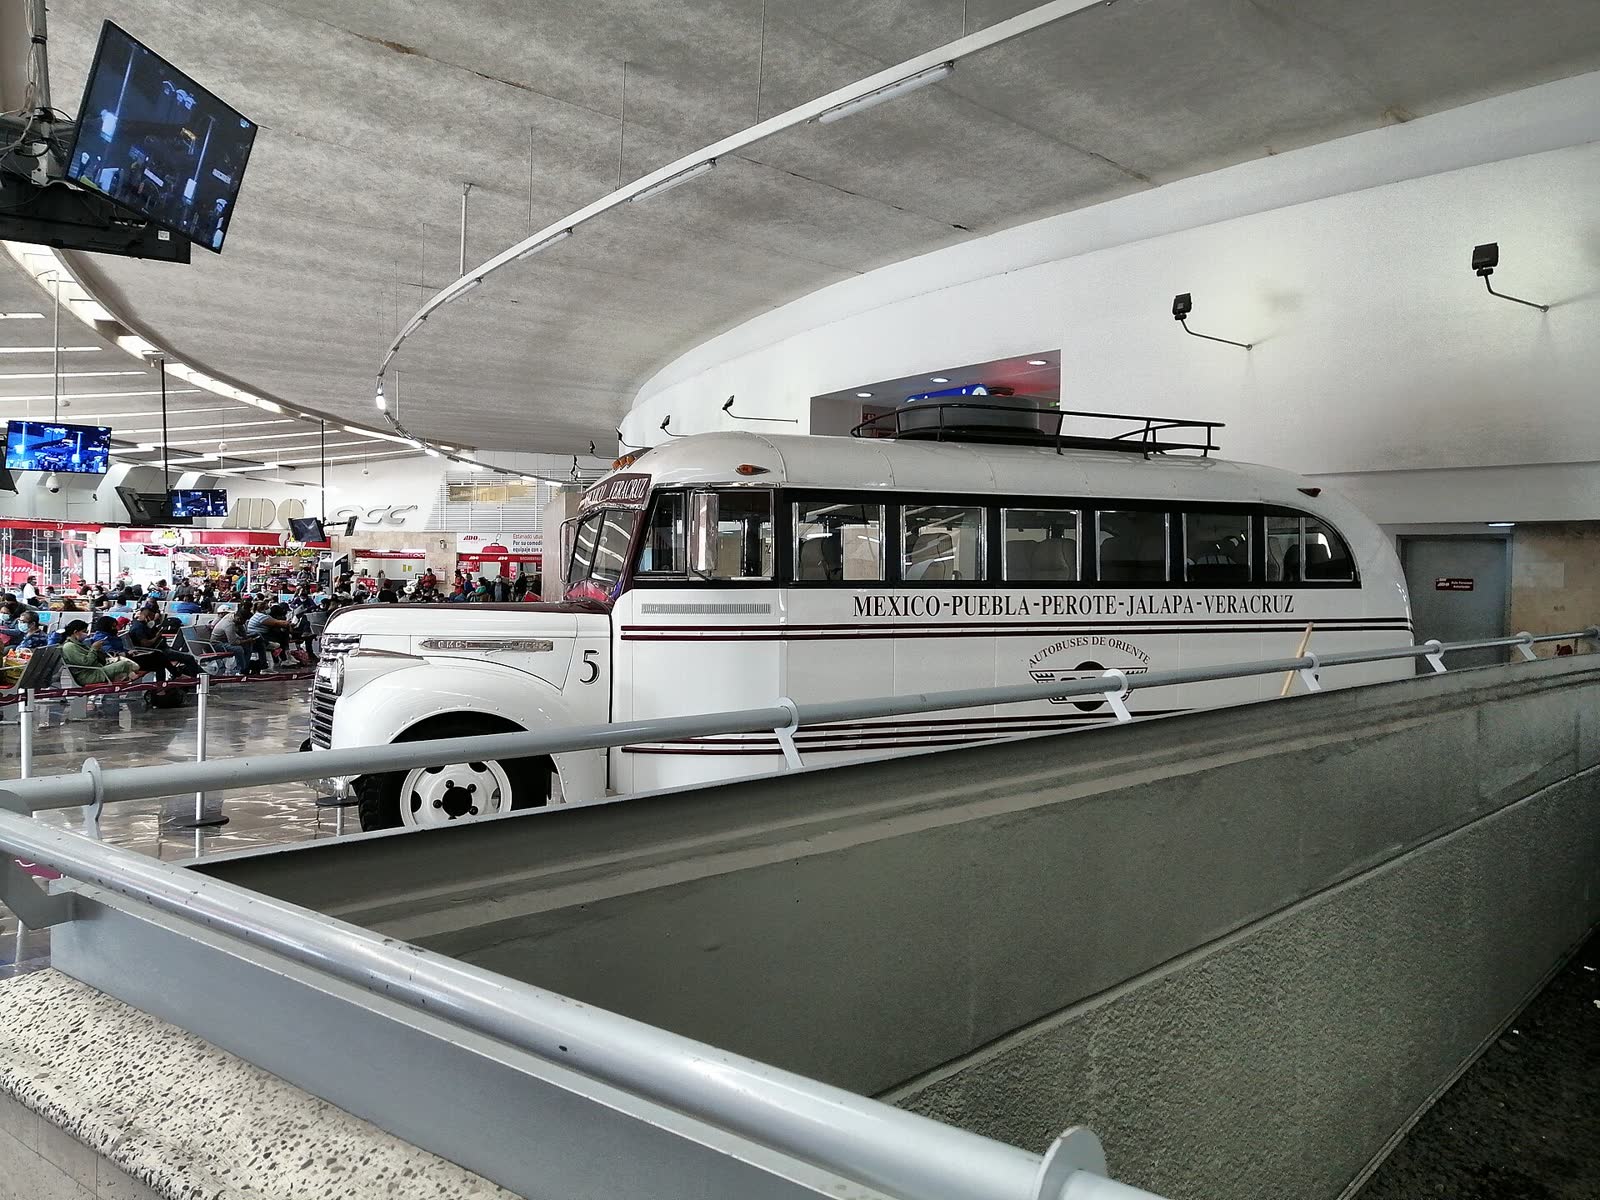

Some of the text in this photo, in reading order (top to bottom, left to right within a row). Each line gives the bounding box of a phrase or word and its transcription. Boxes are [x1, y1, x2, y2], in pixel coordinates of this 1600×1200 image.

[608, 478, 649, 500] VERACRUZ
[579, 649, 600, 686] 5
[1028, 636, 1152, 669] AUTOBUSES DE ORIENTE
